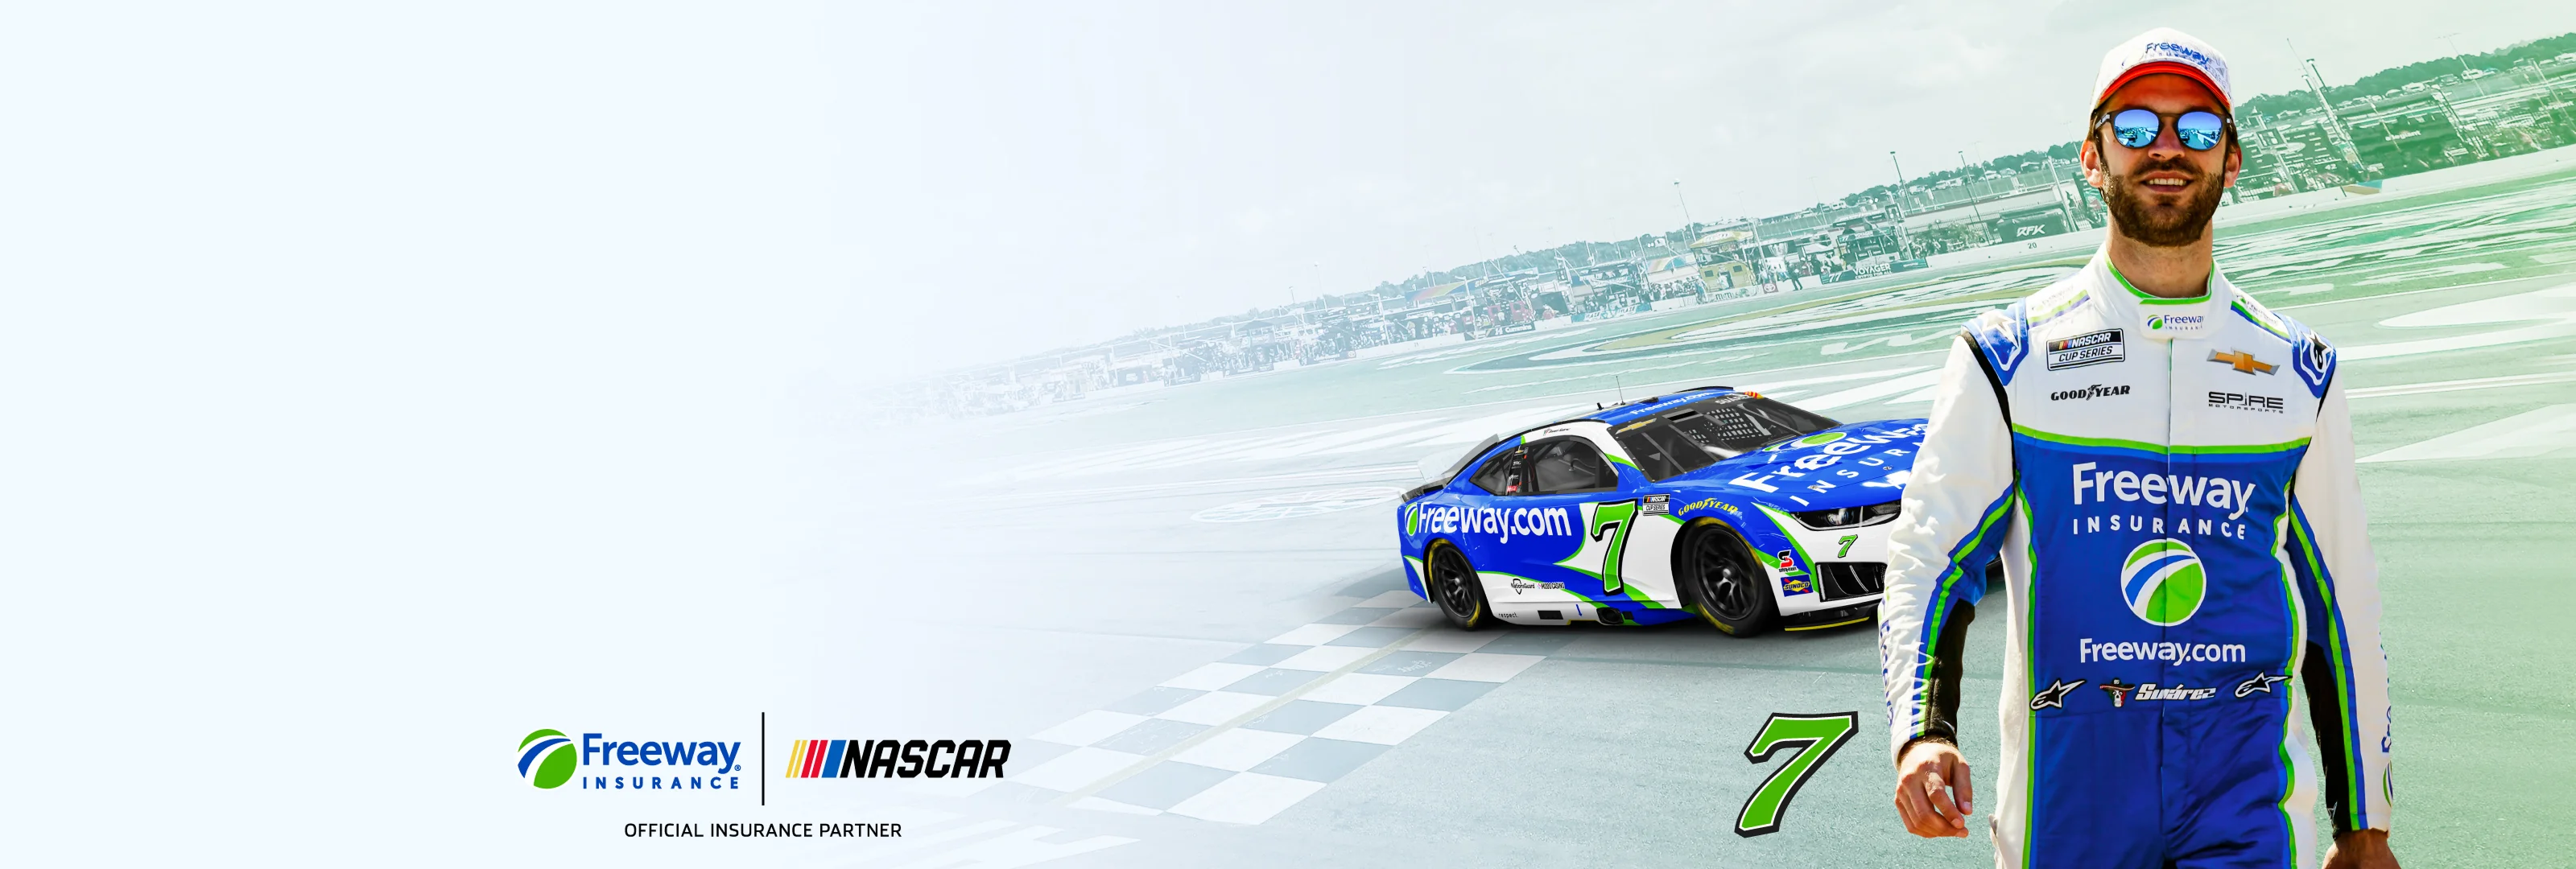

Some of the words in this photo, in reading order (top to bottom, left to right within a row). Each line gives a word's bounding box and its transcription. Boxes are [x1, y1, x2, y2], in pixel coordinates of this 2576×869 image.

[2145, 42, 2210, 65] Freeway
[2017, 224, 2046, 237] RFK
[2028, 241, 2037, 249] 20
[1829, 272, 1843, 283] 77
[1852, 262, 1892, 276] VOYAGER
[2071, 332, 2112, 348] NASCAR
[2058, 351, 2079, 363] CUP
[2079, 345, 2113, 360] SERIES
[1728, 423, 1928, 493] Freewa
[2073, 461, 2256, 521] Freeway
[1418, 502, 1573, 544] Freeway.com
[2073, 514, 2246, 540] INSURANCE
[1591, 499, 1639, 595] 7
[1838, 534, 1859, 558] 7
[1784, 582, 1810, 591] SUNOCO
[2080, 638, 2246, 666] Freeway.com
[2135, 683, 2217, 702] Suárez
